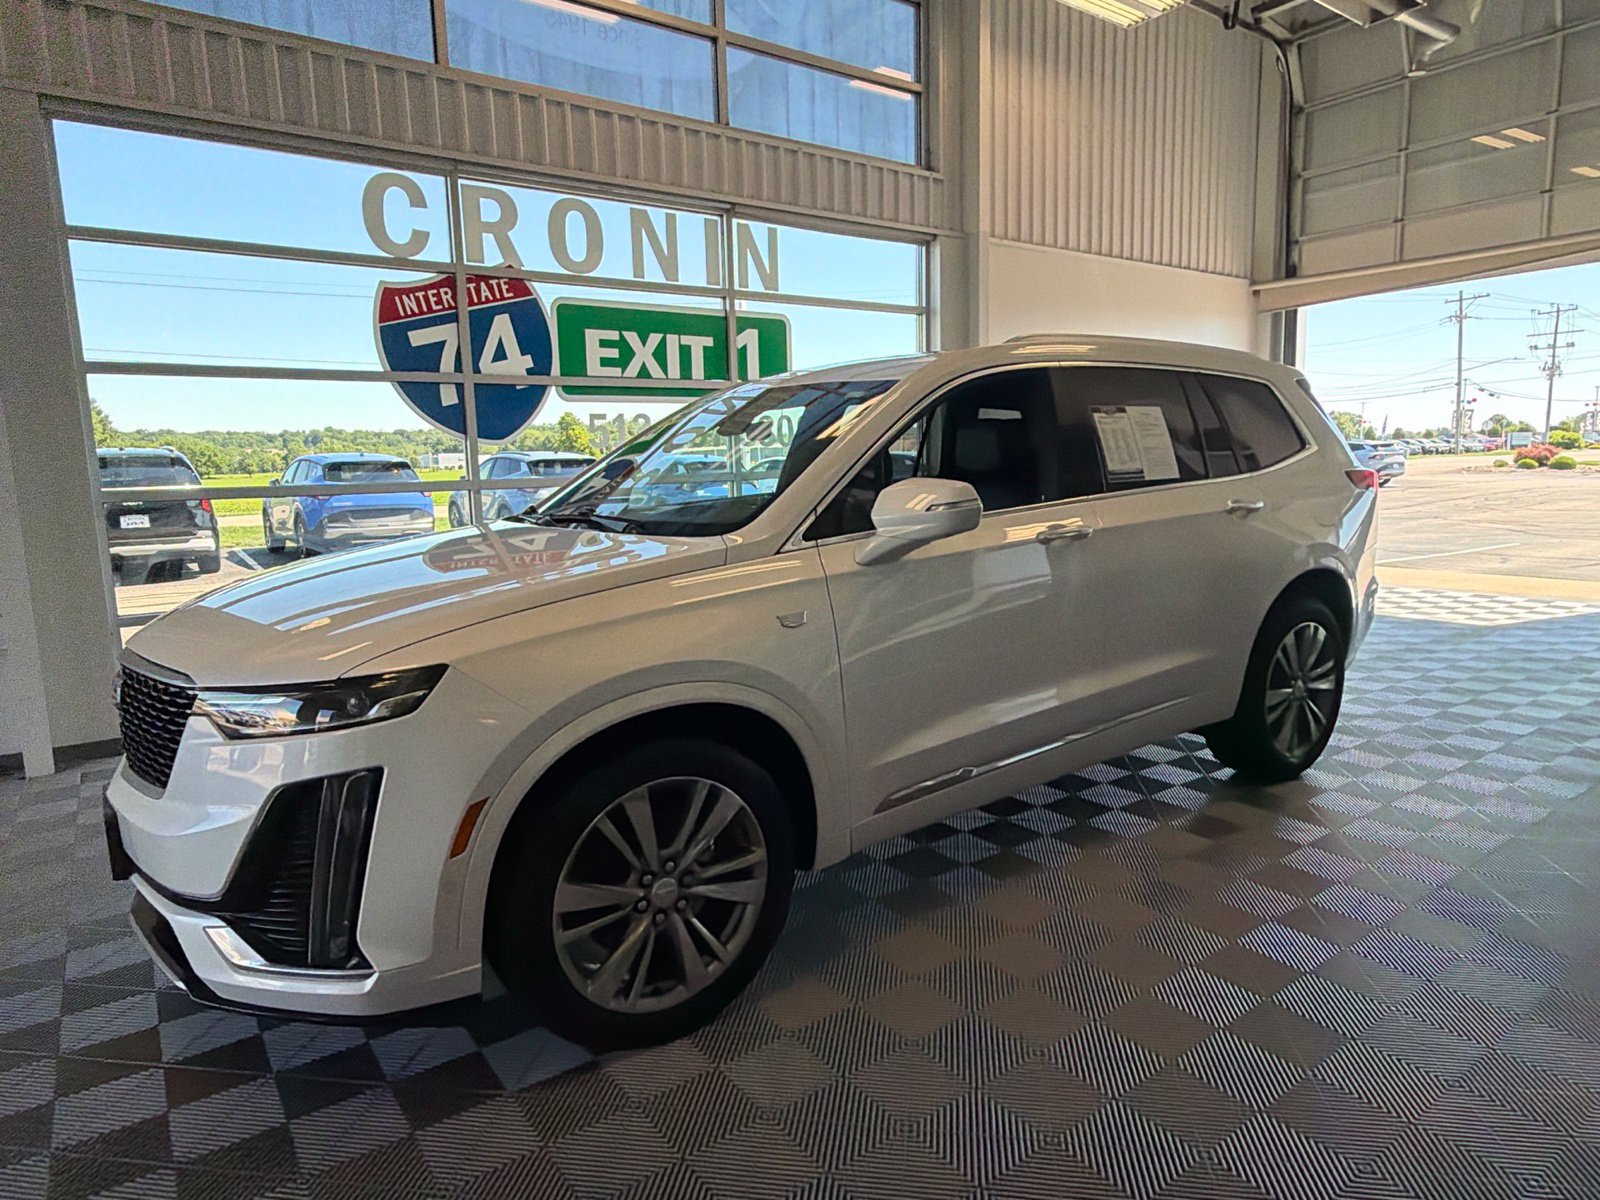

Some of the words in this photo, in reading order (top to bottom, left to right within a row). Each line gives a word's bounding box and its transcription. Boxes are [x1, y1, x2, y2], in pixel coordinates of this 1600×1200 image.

[362, 171, 780, 292] CRONIN
[394, 275, 514, 317] INTERTATE
[407, 313, 534, 407] 74
[584, 328, 714, 380] EXIT
[735, 328, 760, 380] 1
